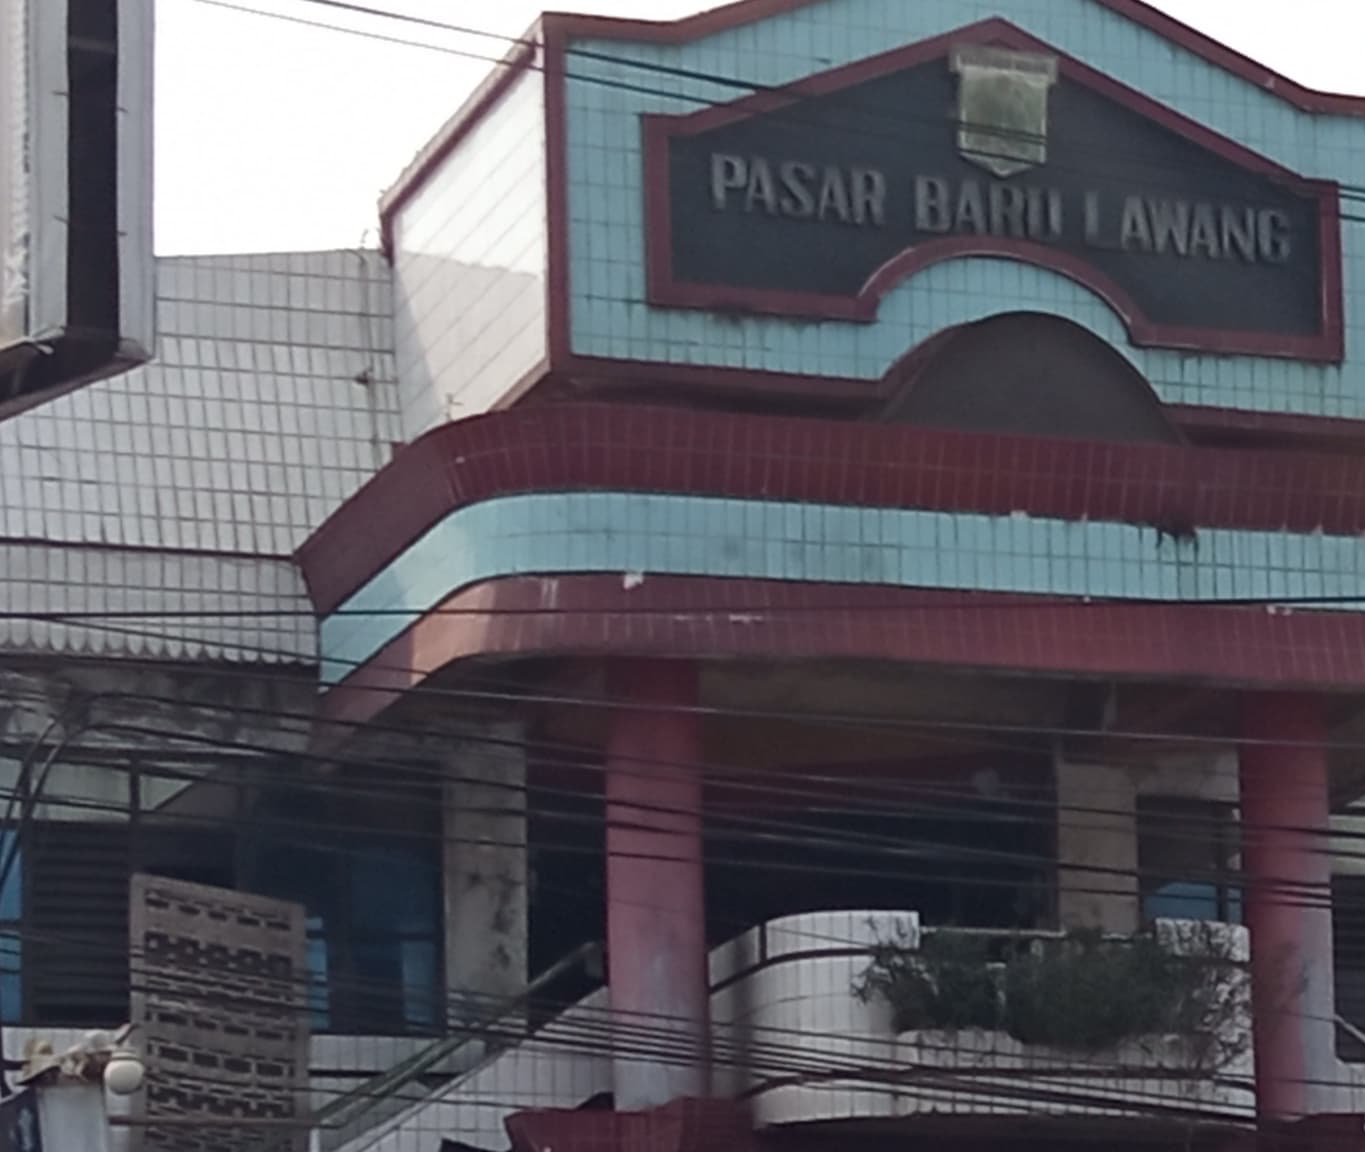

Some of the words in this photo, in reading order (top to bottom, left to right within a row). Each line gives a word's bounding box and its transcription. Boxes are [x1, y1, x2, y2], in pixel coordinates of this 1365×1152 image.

[709, 152, 886, 226] PASAR
[914, 175, 1062, 239] BARU
[1084, 189, 1291, 264] LAWANG
